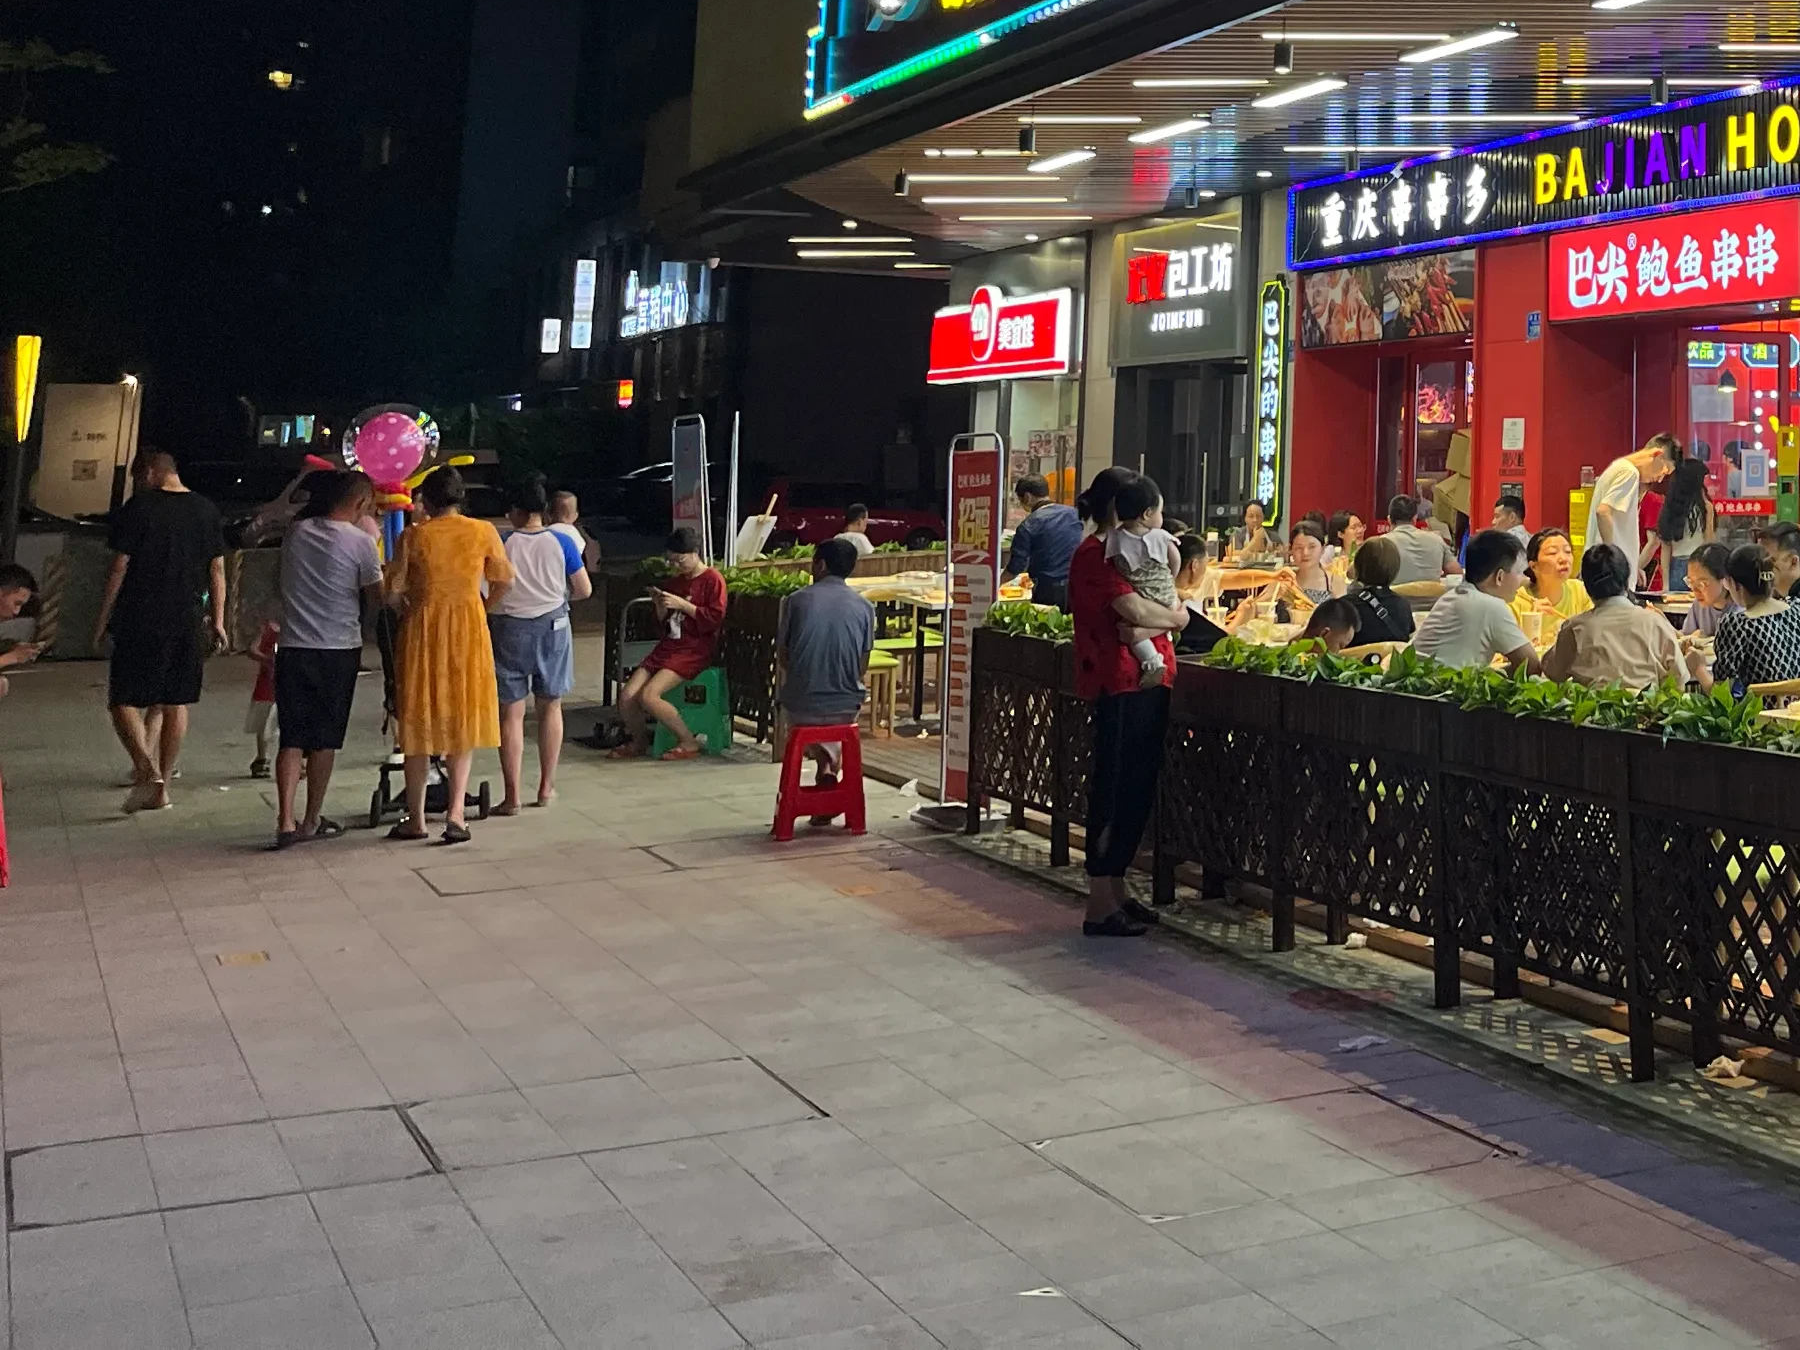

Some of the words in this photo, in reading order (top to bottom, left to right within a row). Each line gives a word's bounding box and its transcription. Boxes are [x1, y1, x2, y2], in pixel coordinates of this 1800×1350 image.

[1320, 164, 1488, 248] 重庆串串多
[1258, 300, 1280, 506] 巴尖的串串
